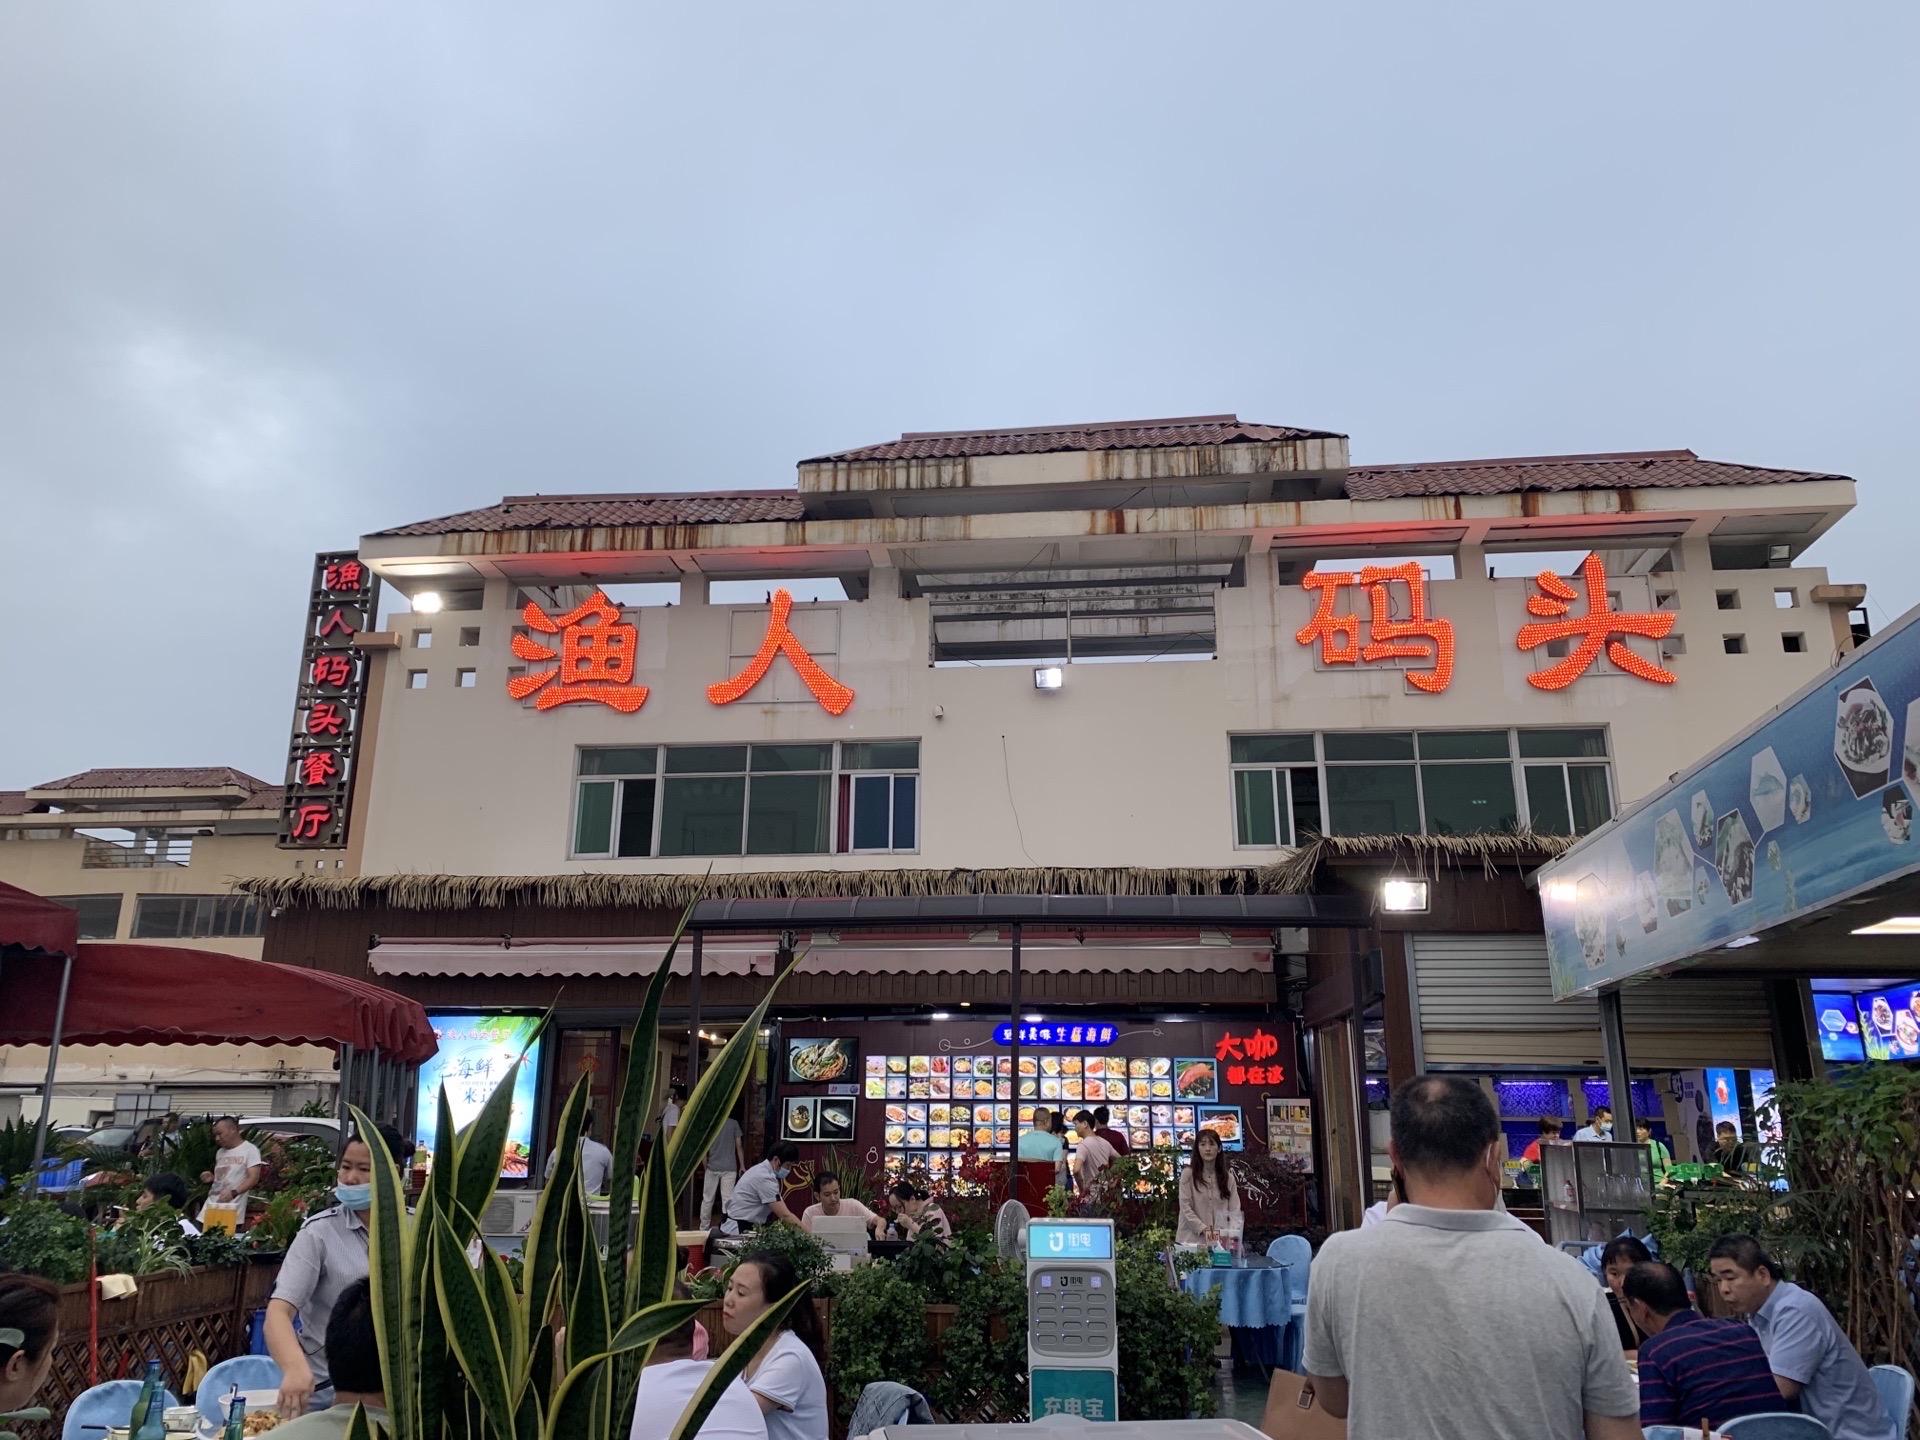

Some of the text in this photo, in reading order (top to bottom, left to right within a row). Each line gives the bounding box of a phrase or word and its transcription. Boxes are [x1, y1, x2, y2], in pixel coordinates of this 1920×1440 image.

[507, 552, 1678, 716] 渔人 码头
[1215, 1028, 1278, 1061] 大咖
[1227, 1065, 1284, 1085] 都在这
[1067, 1232, 1091, 1247] 街电
[1043, 1397, 1104, 1418] 充电宝
